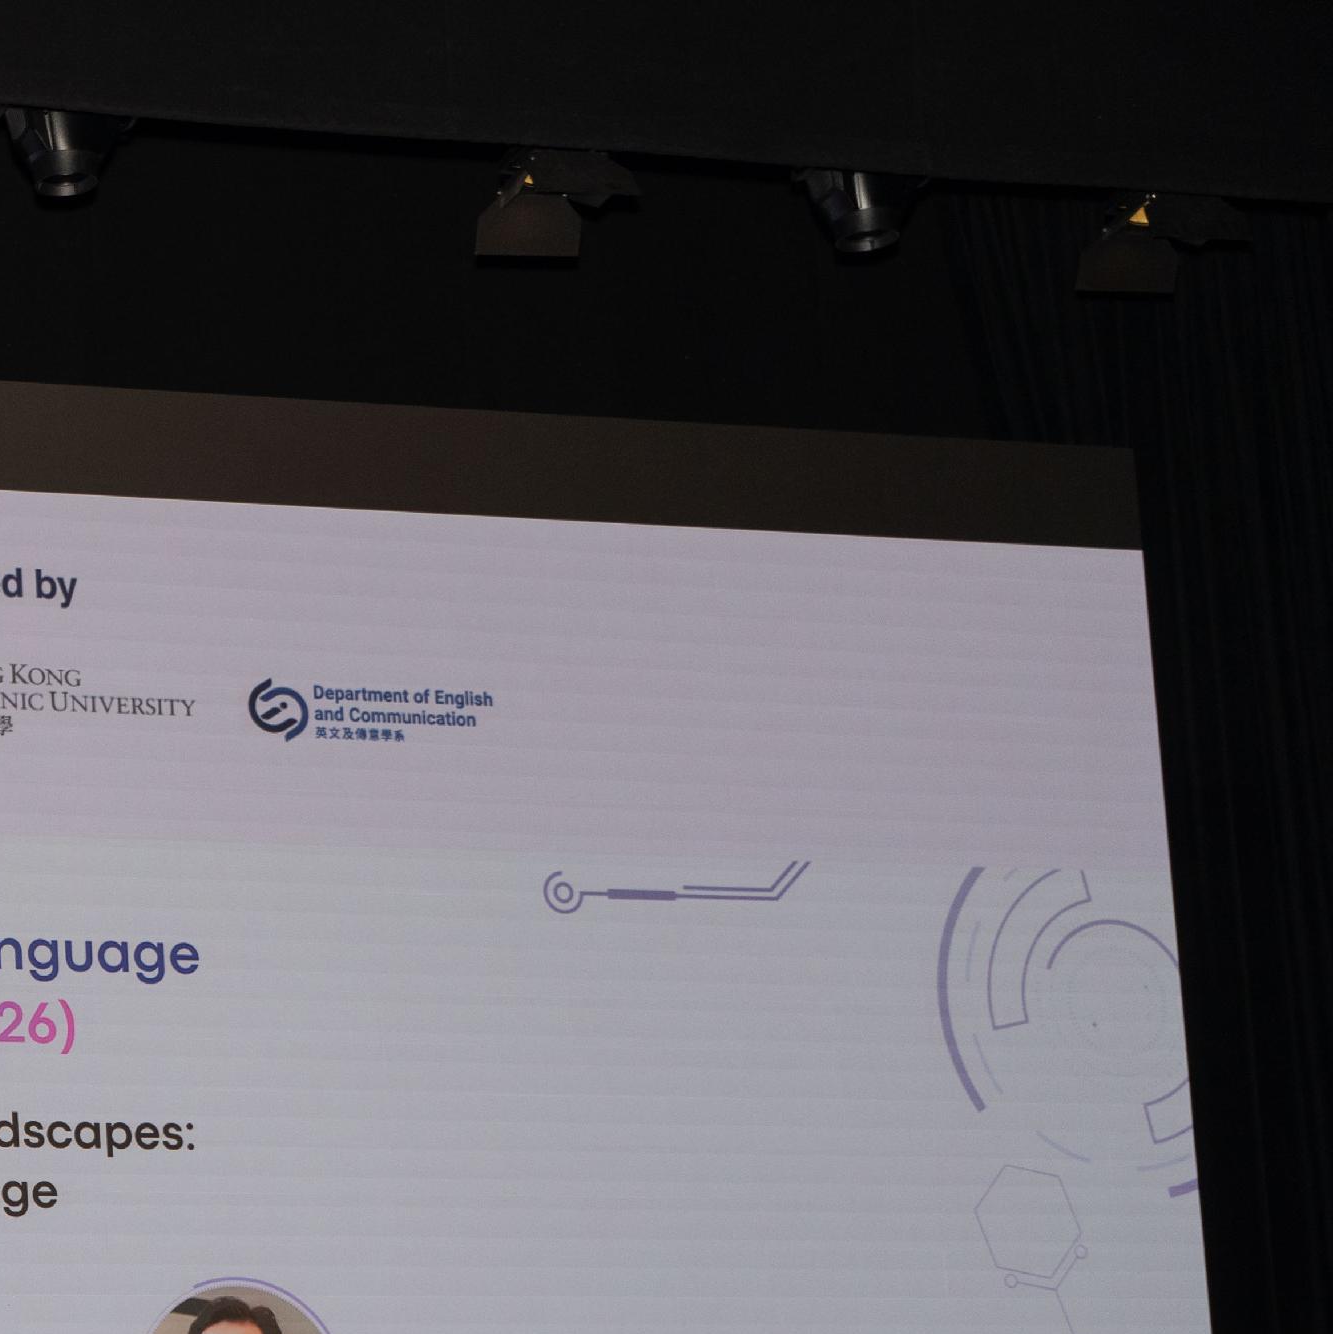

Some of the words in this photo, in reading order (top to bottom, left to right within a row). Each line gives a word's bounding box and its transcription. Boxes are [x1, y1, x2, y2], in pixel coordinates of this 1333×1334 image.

[35, 569, 77, 608] by
[314, 685, 409, 704] Department
[413, 689, 429, 704] of
[435, 690, 493, 709] English
[315, 706, 344, 721] and
[349, 707, 476, 727] Communication
